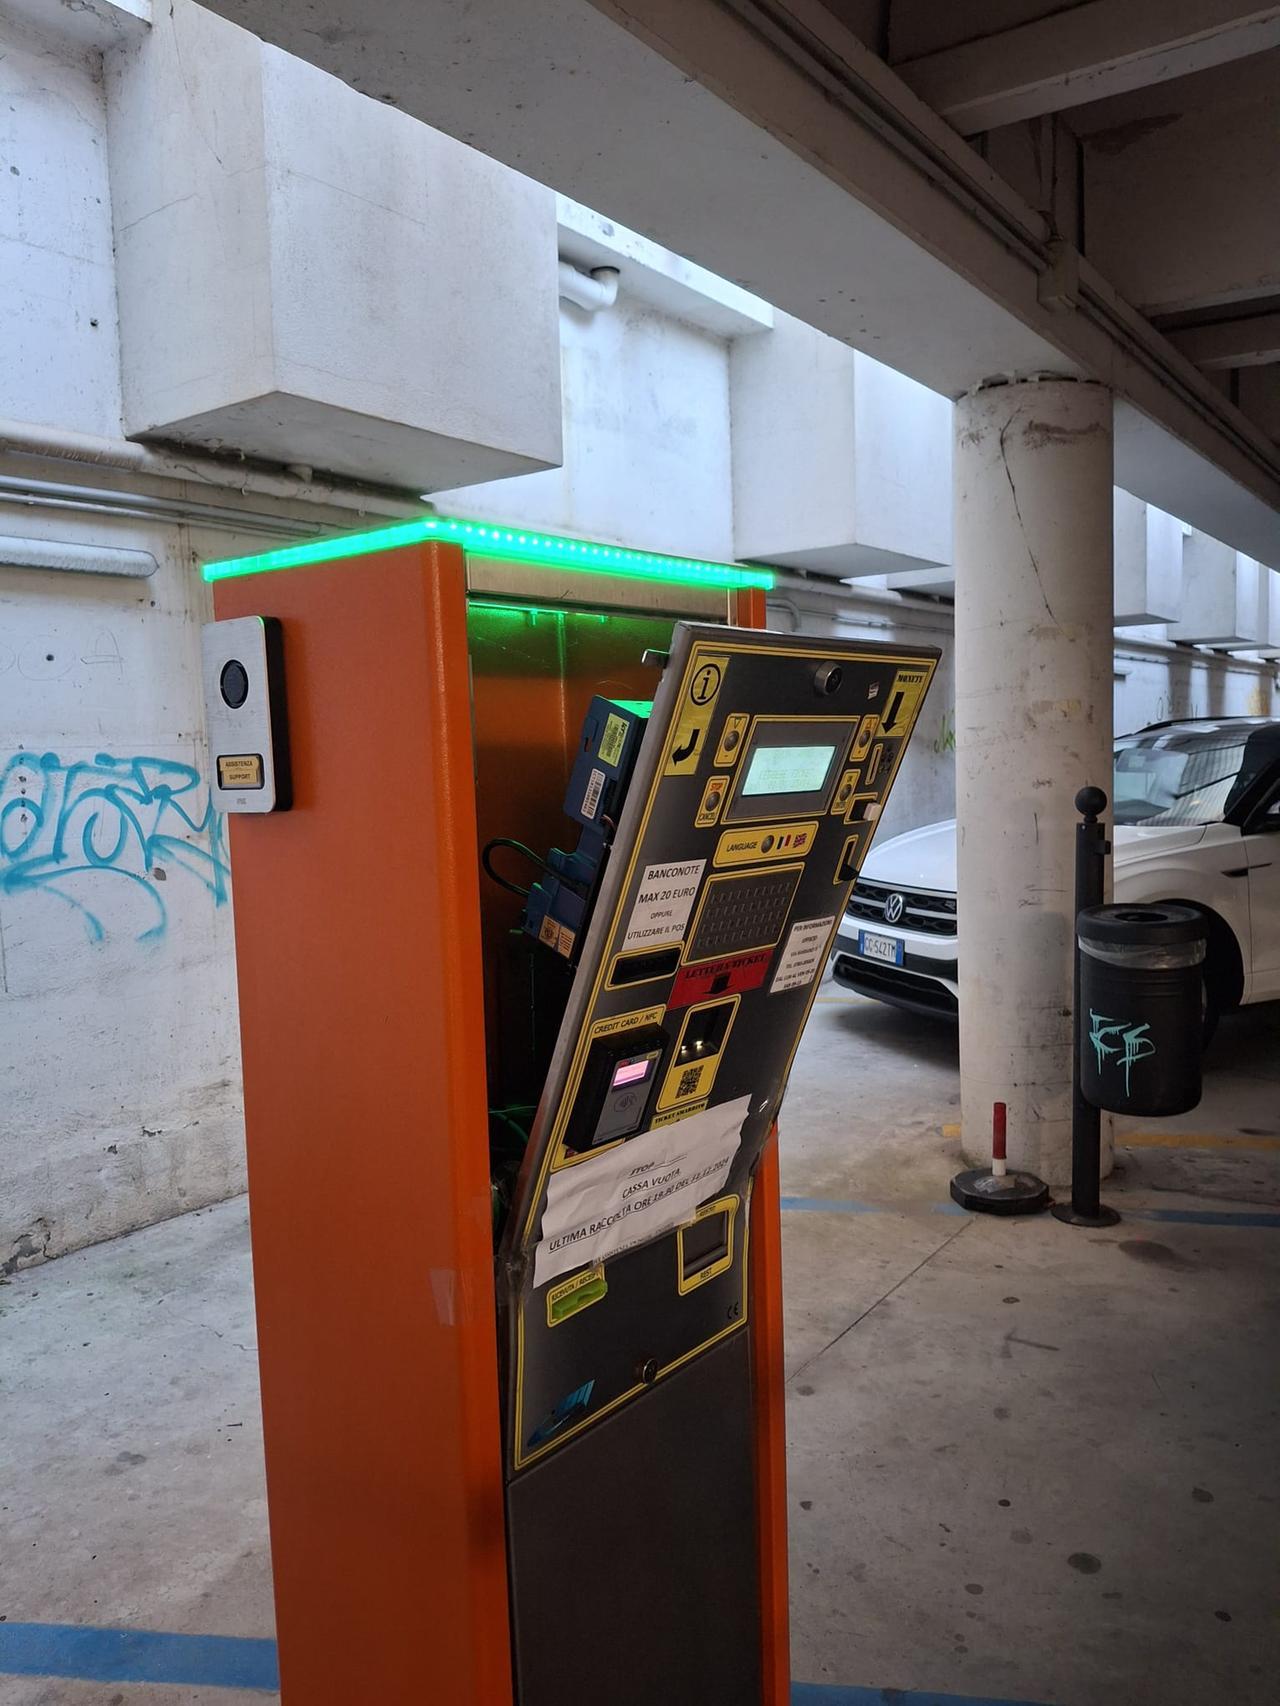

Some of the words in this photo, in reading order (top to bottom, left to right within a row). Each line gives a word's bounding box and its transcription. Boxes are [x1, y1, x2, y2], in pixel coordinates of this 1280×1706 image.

[726, 841, 758, 852] LANGUAGE
[647, 864, 701, 880] BANCONOTE
[638, 891, 660, 904] MAX
[660, 890, 672, 901] 20
[672, 886, 696, 899] EURO
[627, 926, 665, 940] UTILIZZARE
[671, 923, 685, 932] POS
[594, 1021, 620, 1034] CREDIT
[620, 1016, 640, 1027] CARD
[644, 1011, 658, 1021] NFC
[630, 1161, 655, 1176] STOP
[622, 1180, 649, 1199] CASSA
[651, 1168, 680, 1186] VUOTA
[549, 1227, 587, 1250] ULTIMA
[634, 1196, 651, 1210] ORE
